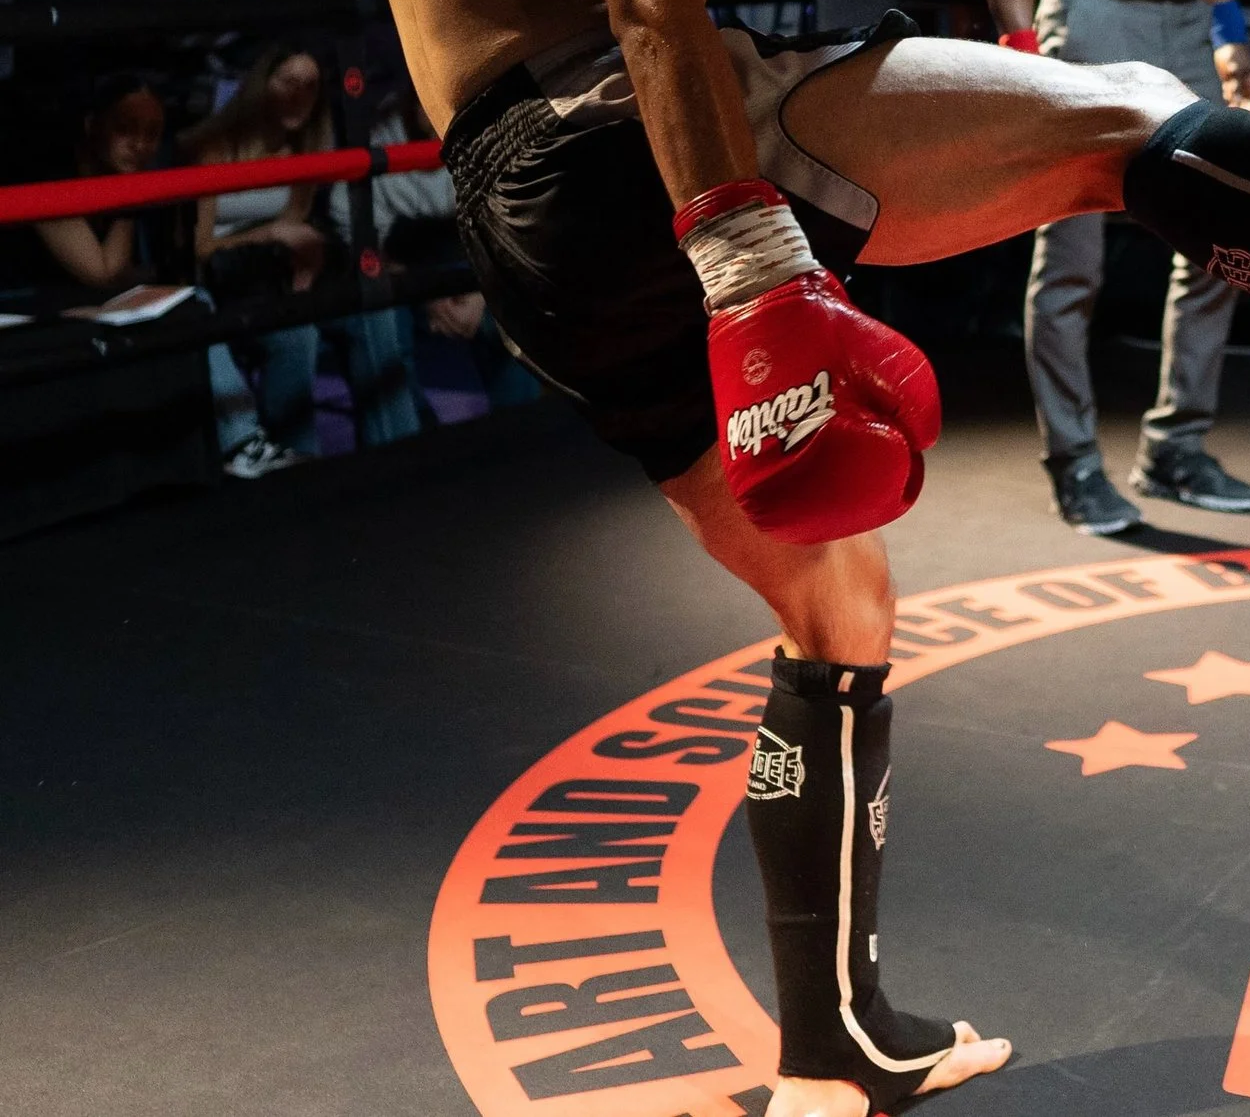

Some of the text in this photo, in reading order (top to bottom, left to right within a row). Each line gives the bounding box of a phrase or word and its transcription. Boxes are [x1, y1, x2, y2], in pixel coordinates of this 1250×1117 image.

[727, 371, 836, 461] Fairtex
[1018, 570, 1160, 609] OF
[592, 596, 1037, 765] SCICE
[479, 779, 701, 904] AND
[473, 929, 743, 1101] ART
